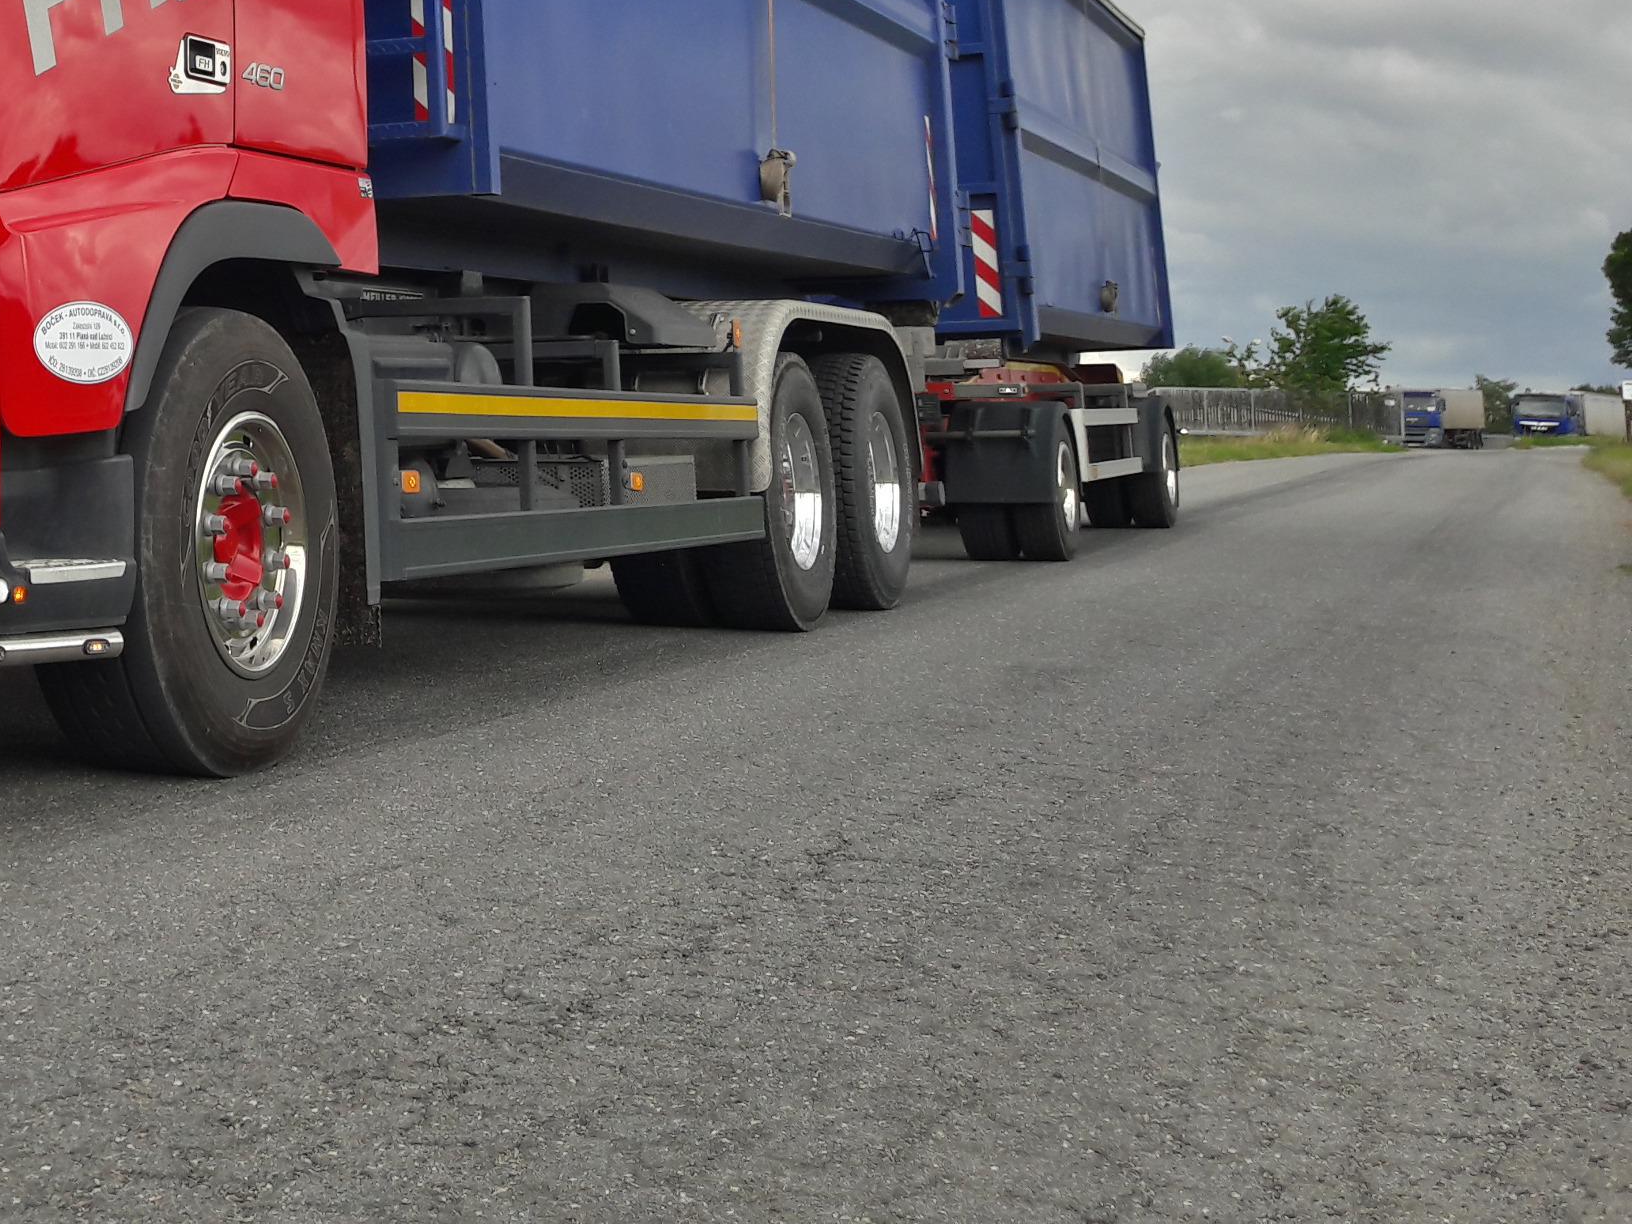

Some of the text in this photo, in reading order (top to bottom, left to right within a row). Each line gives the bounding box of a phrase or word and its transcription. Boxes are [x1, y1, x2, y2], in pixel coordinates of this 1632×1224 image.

[198, 58, 210, 69] FH
[241, 62, 285, 91] 460
[41, 312, 65, 335] BOČEK
[68, 307, 113, 323] AUTODOPRAVA
